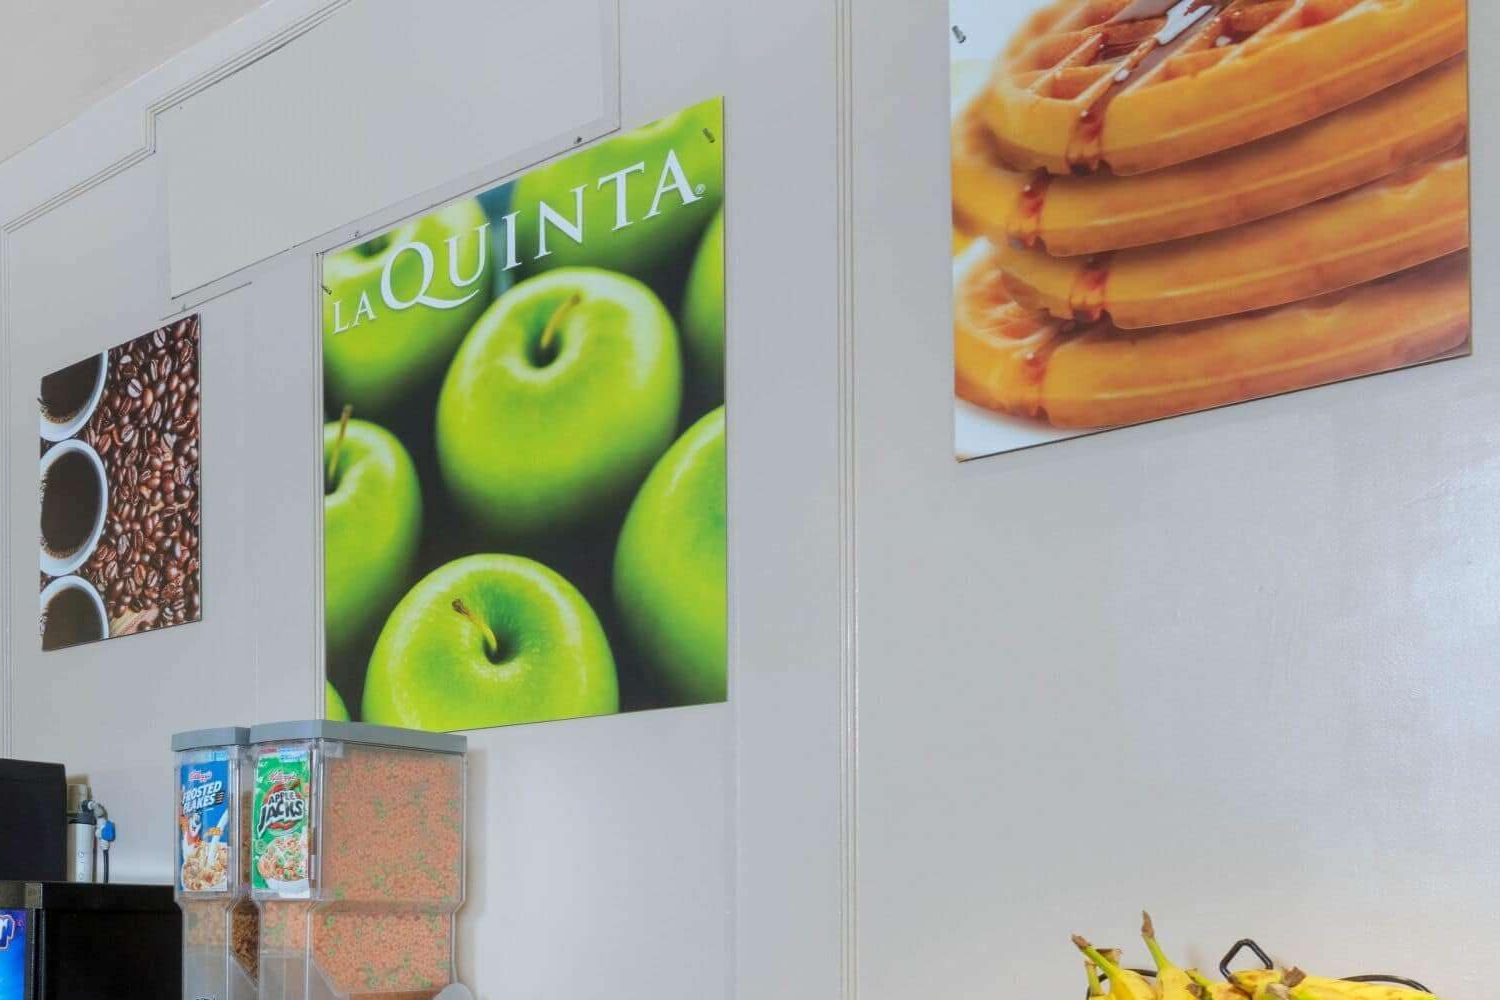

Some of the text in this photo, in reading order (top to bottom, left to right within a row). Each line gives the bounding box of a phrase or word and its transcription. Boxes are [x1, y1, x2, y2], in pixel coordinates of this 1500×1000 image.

[332, 148, 703, 334] LA QUINTA
[258, 800, 303, 832] JACKS
